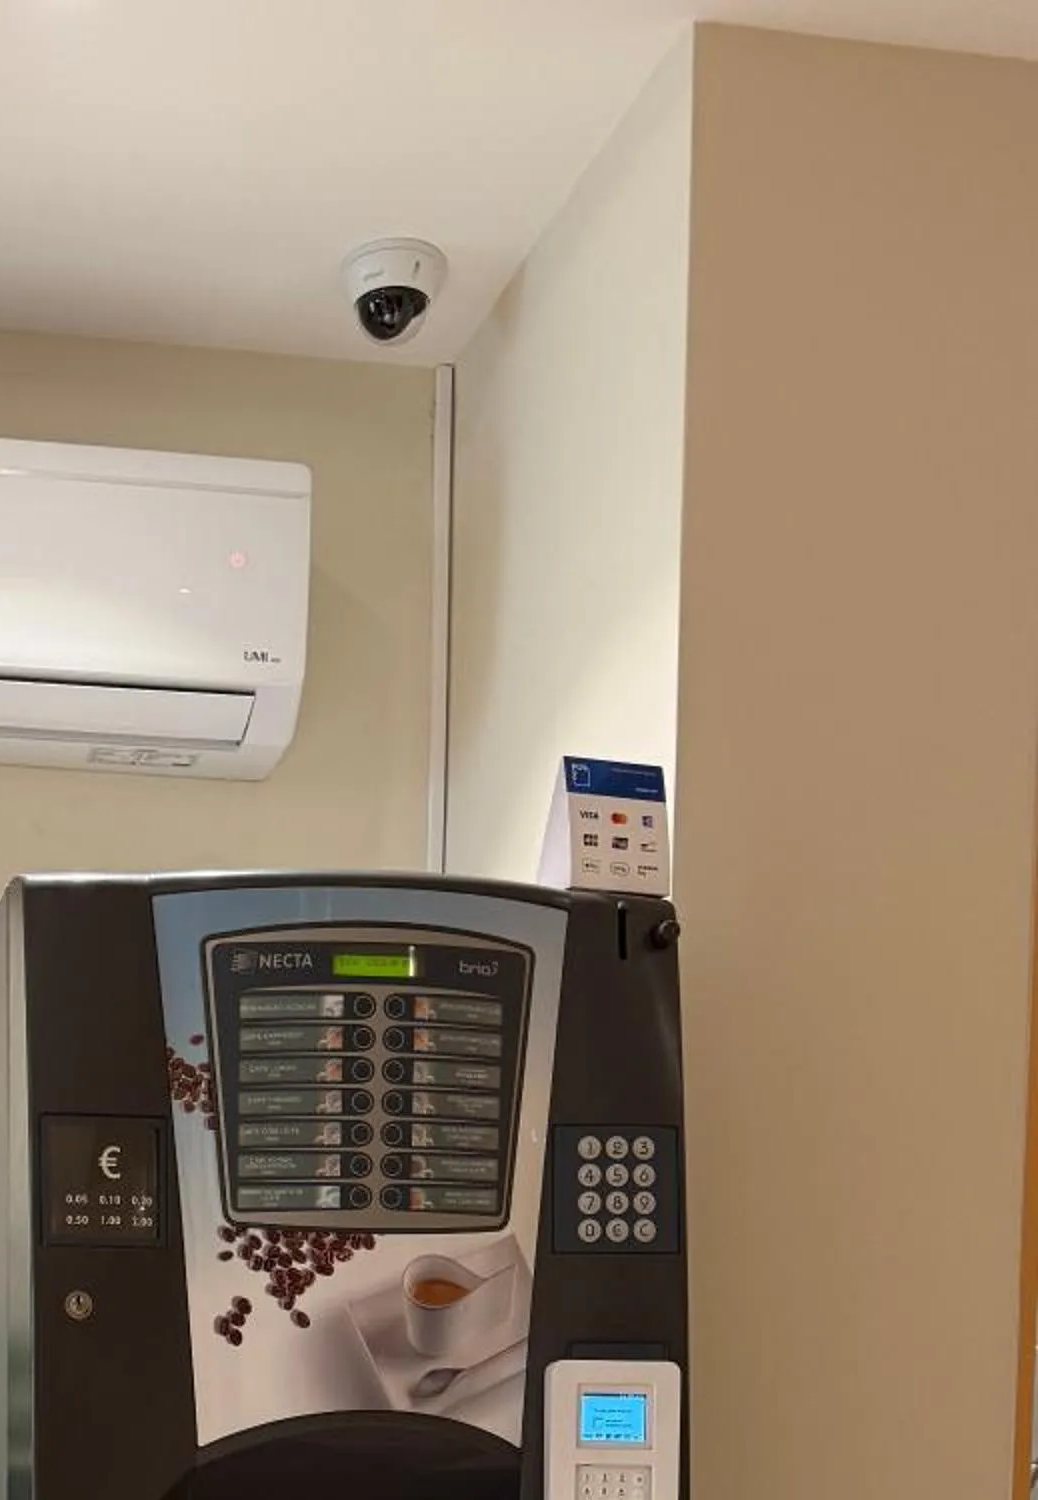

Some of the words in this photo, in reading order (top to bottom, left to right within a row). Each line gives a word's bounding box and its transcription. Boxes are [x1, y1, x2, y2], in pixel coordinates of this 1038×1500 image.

[258, 953, 313, 970] NECTA
[612, 1141, 623, 1155] 2
[640, 1141, 649, 1155] 3
[98, 1145, 121, 1179] €
[585, 1169, 594, 1182] 4
[612, 1168, 623, 1182] 5
[640, 1168, 649, 1182] 6
[585, 1195, 595, 1210] 7
[612, 1195, 623, 1210] 8
[639, 1195, 649, 1210] 9
[65, 1215, 90, 1225] 0.50
[585, 1223, 595, 1237] 0
[639, 1223, 650, 1237] C
